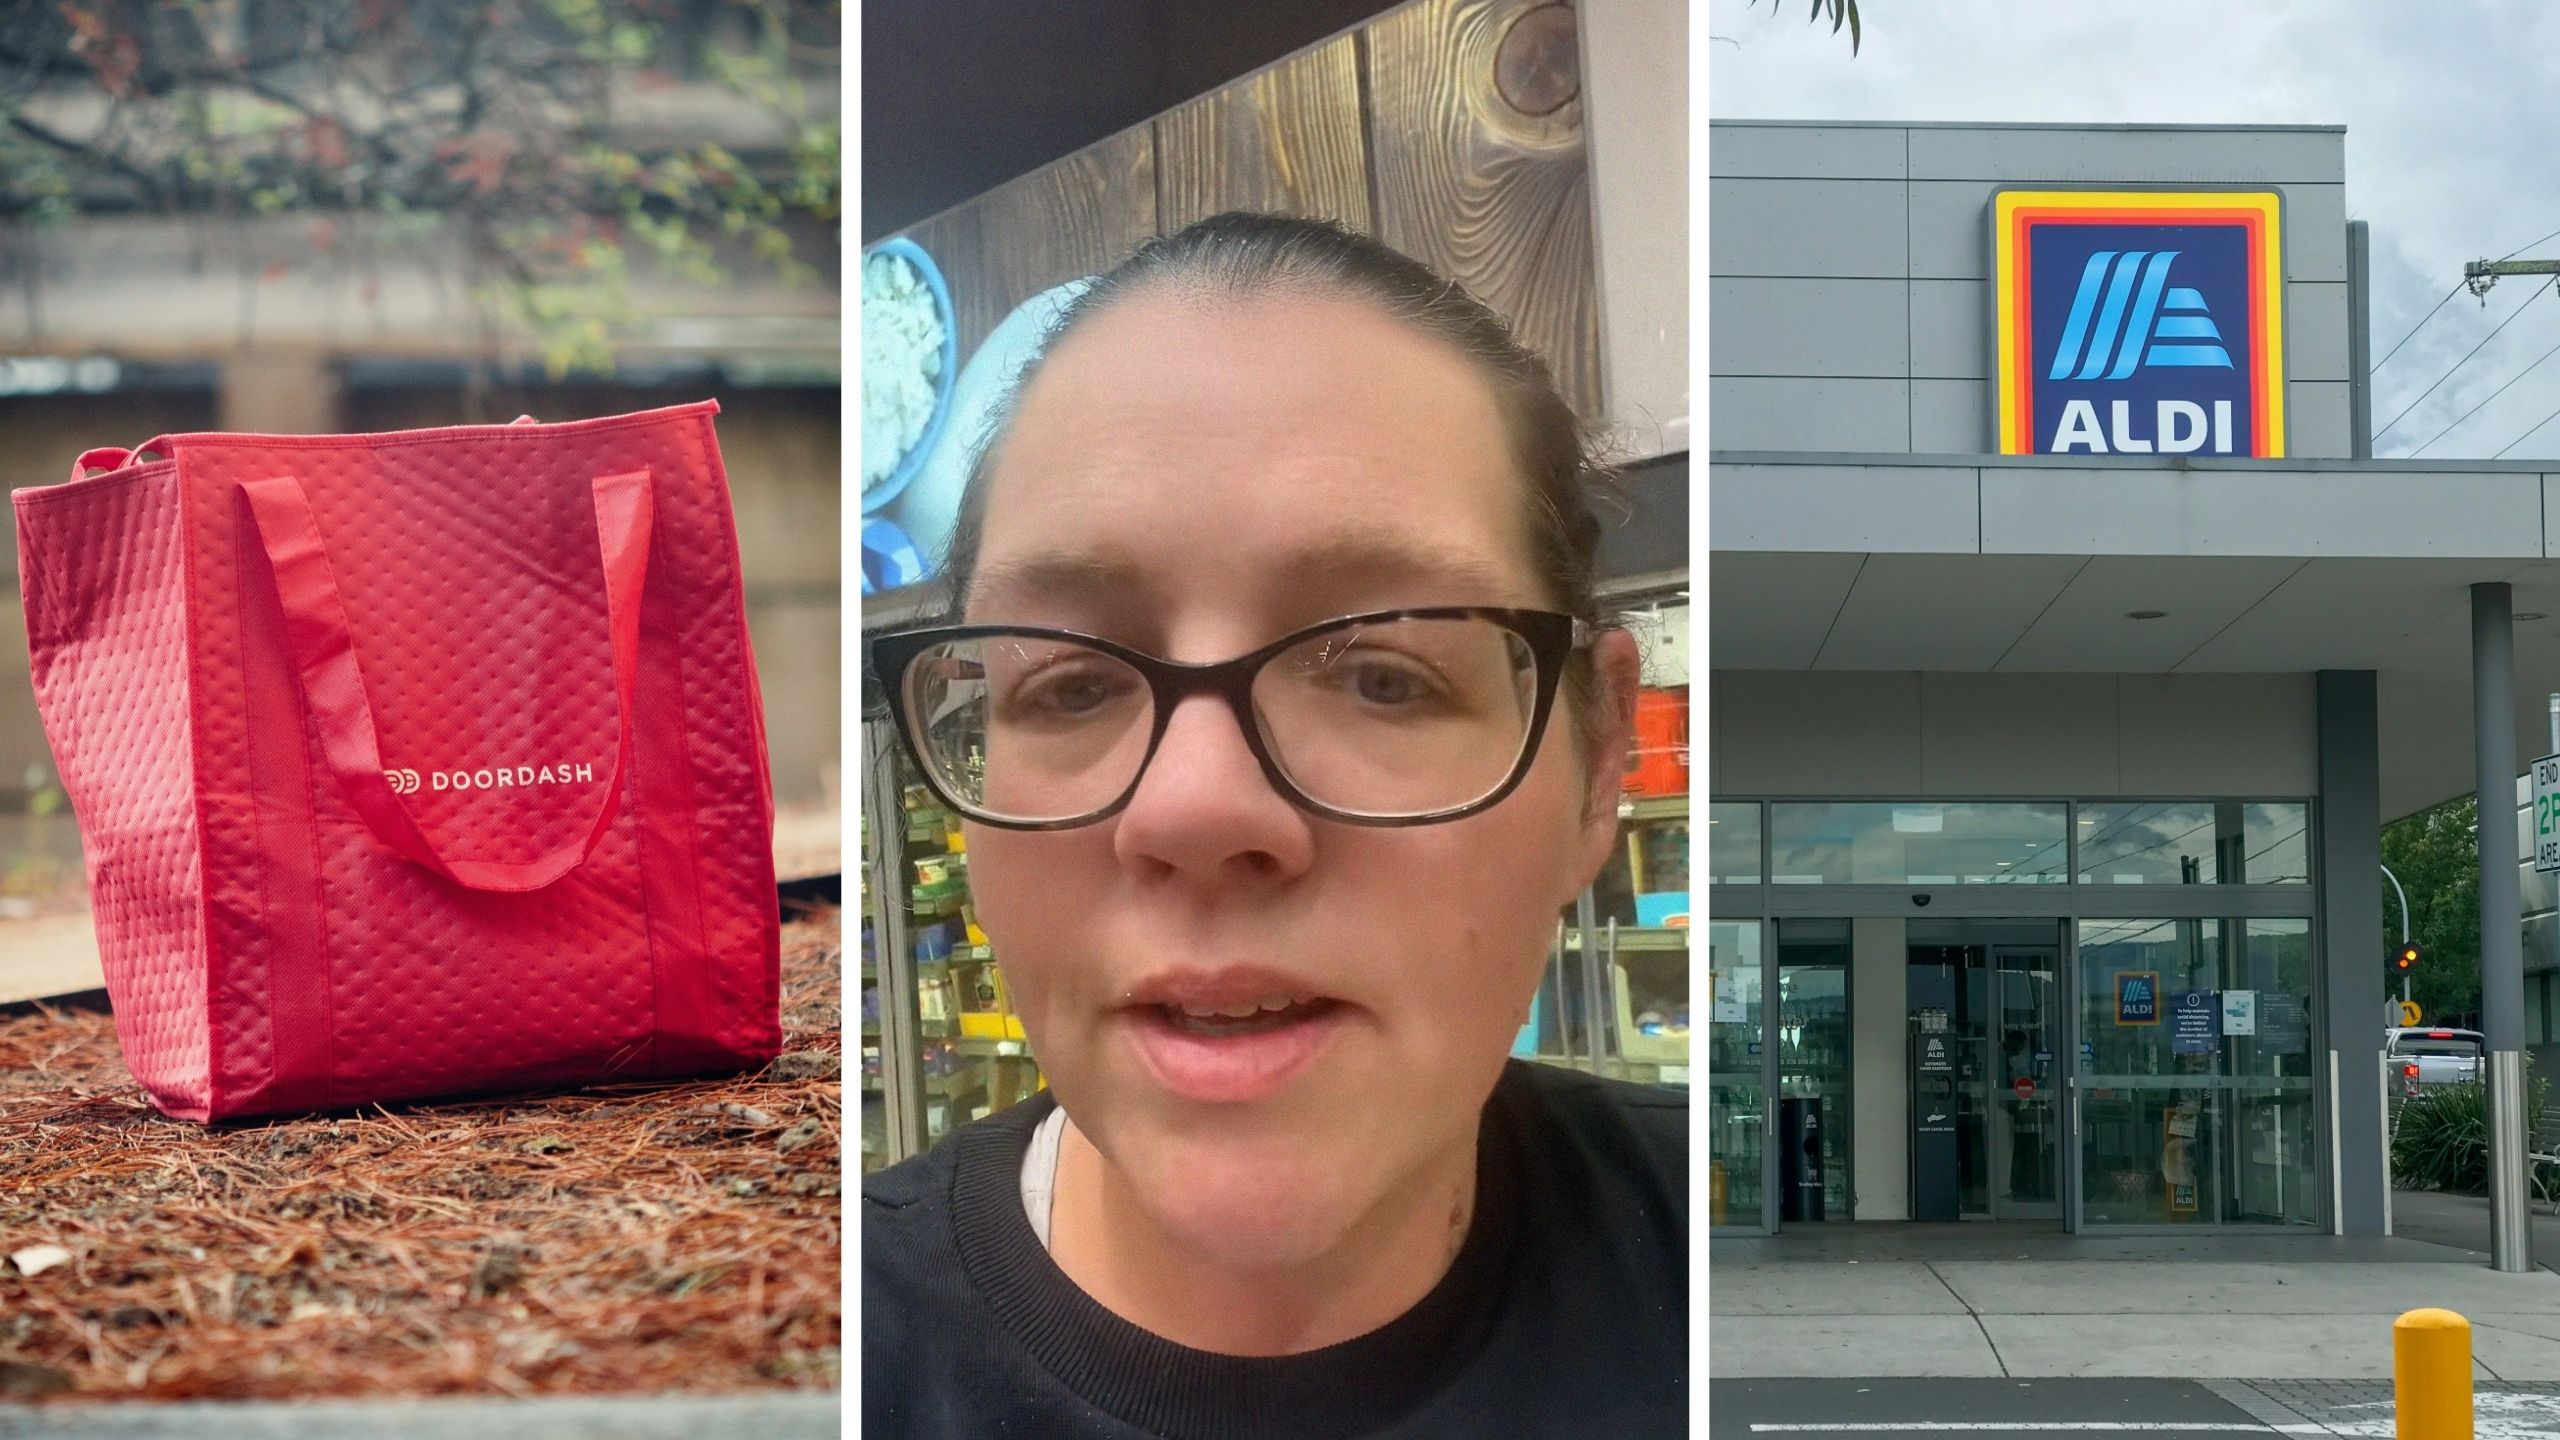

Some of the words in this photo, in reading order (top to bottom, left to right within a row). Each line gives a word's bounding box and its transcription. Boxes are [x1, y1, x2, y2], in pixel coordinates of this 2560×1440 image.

[2050, 399, 2233, 453] ALDI
[432, 763, 593, 790] DOORDASH
[2540, 763, 2559, 786] END
[2540, 841, 2560, 866] ARE
[2122, 1004, 2153, 1014] ALDI
